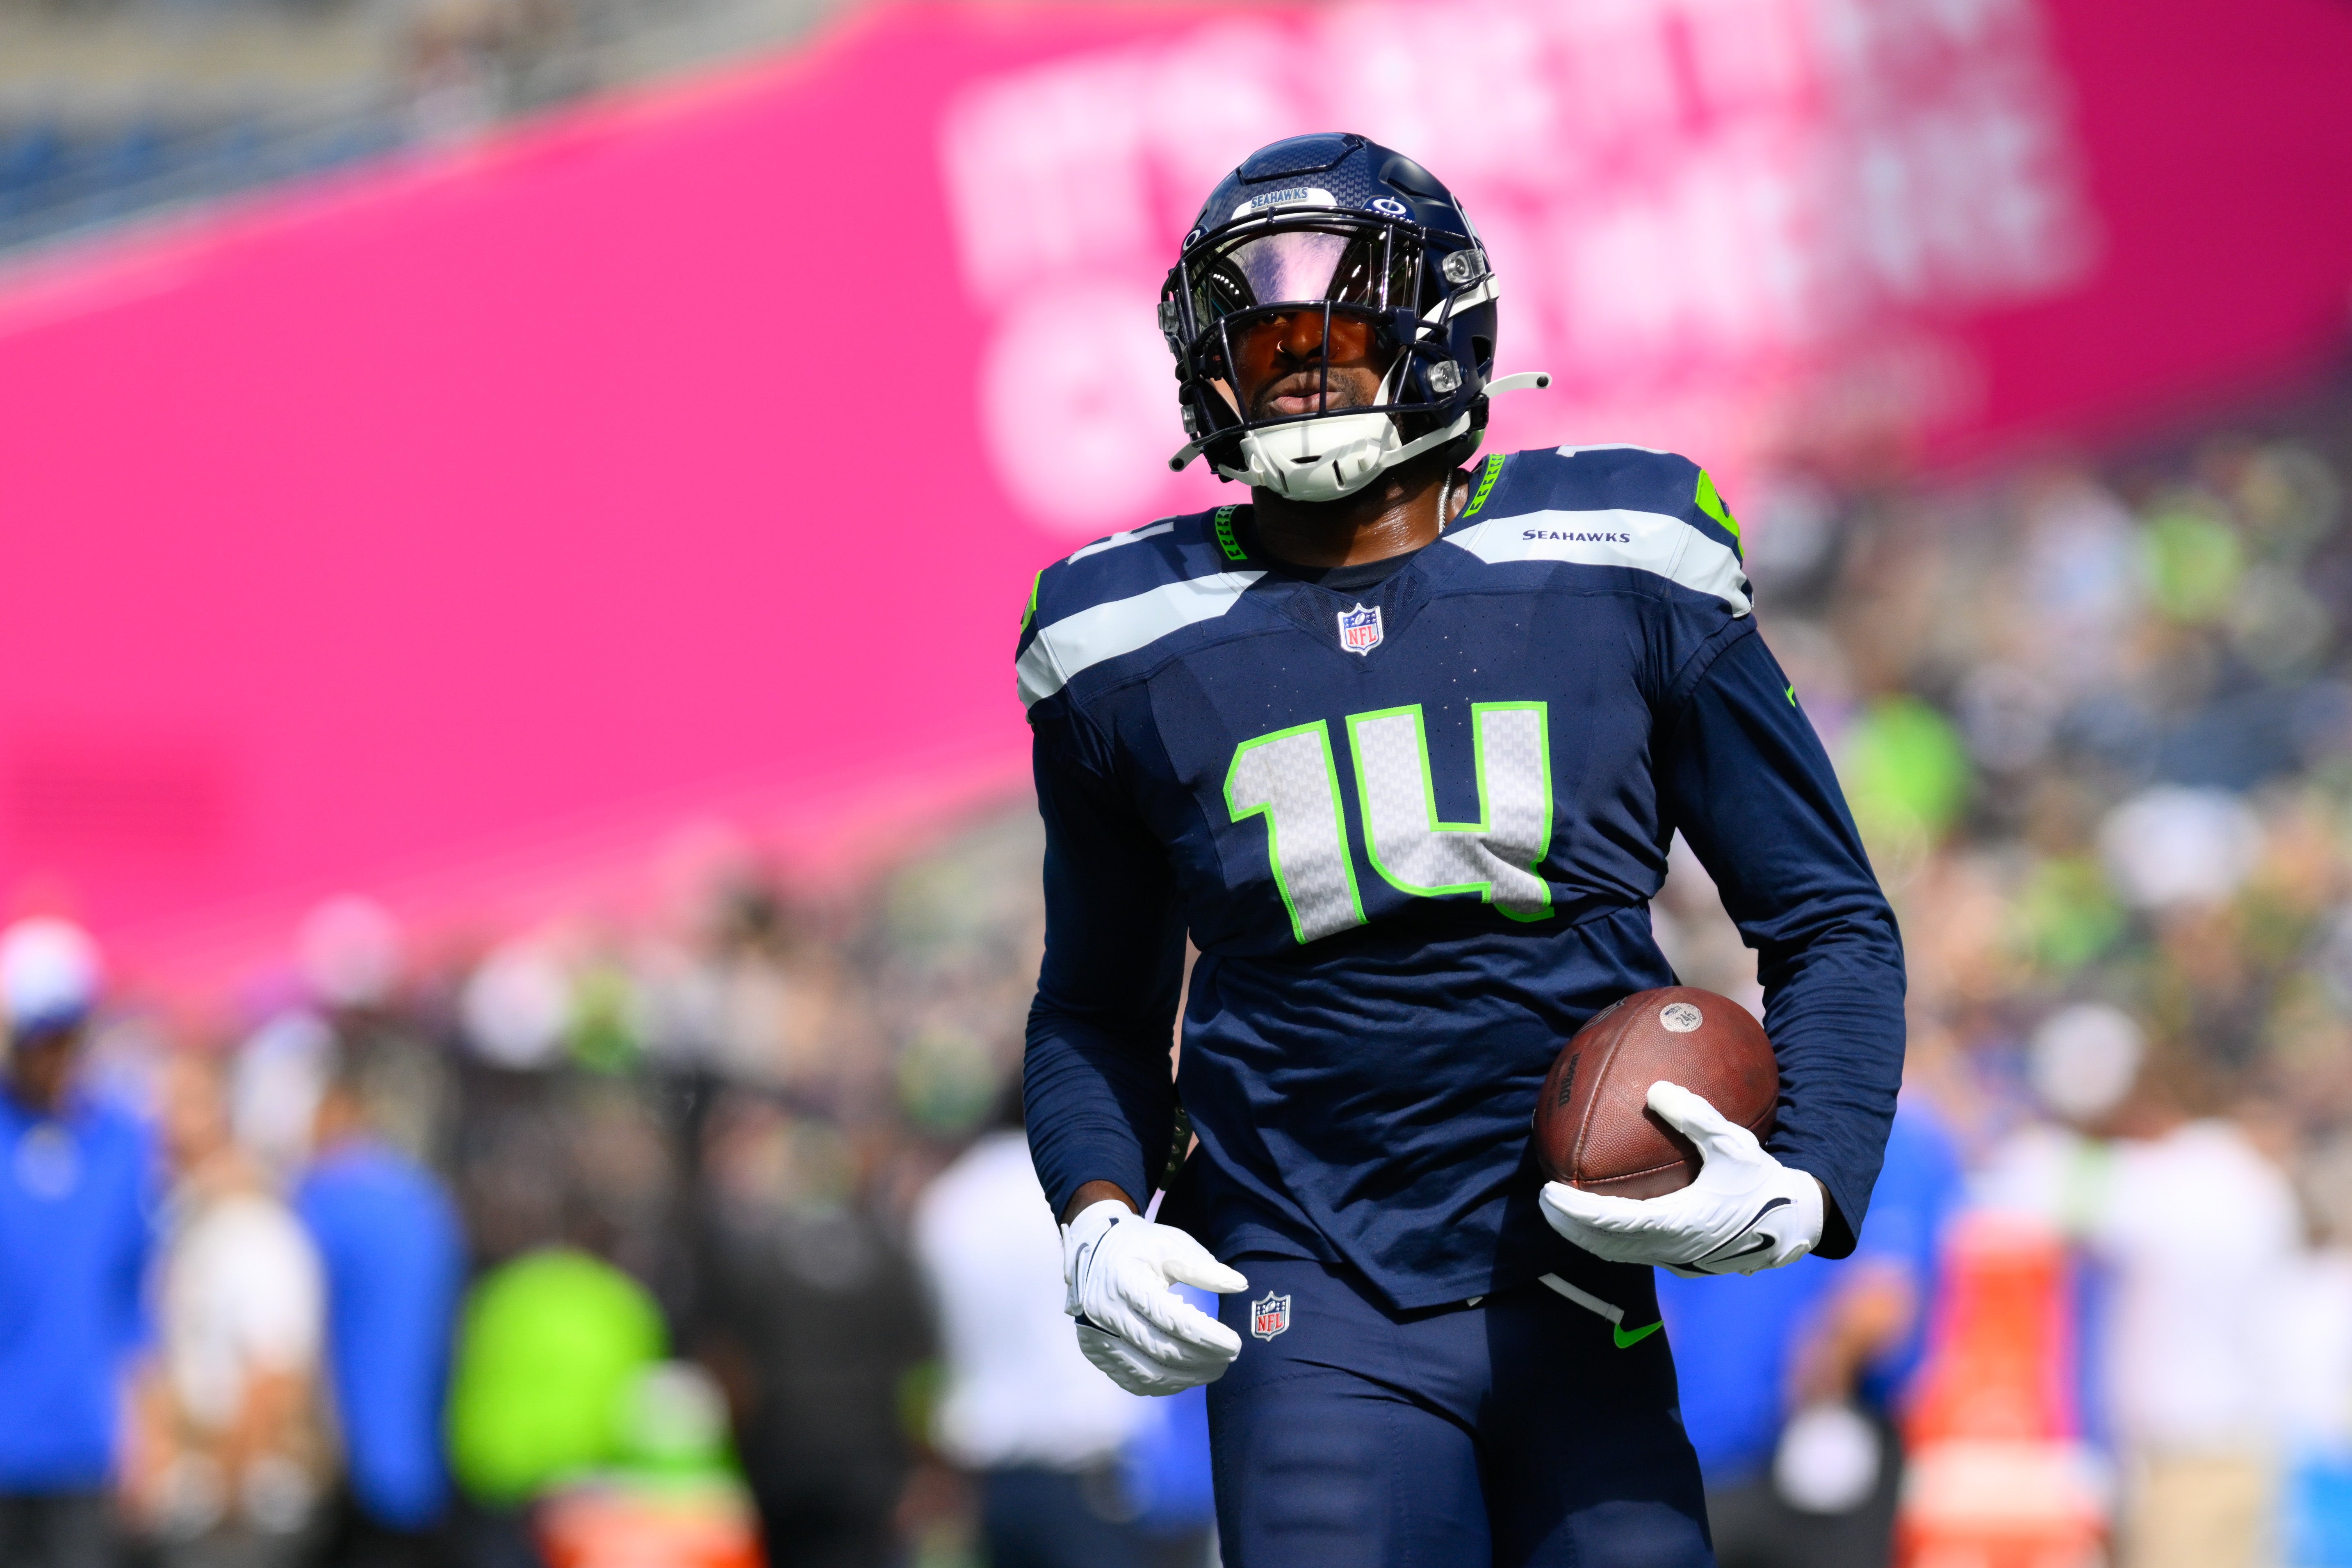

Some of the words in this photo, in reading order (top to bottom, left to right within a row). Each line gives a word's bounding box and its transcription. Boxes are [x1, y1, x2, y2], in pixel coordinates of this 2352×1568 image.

[1251, 187, 1309, 208] SEAHAWKS
[1522, 529, 1630, 543] SEAHAWKS
[1347, 625, 1377, 646] NFL
[1223, 700, 1554, 945] 14
[1258, 1313, 1283, 1332] NFL
